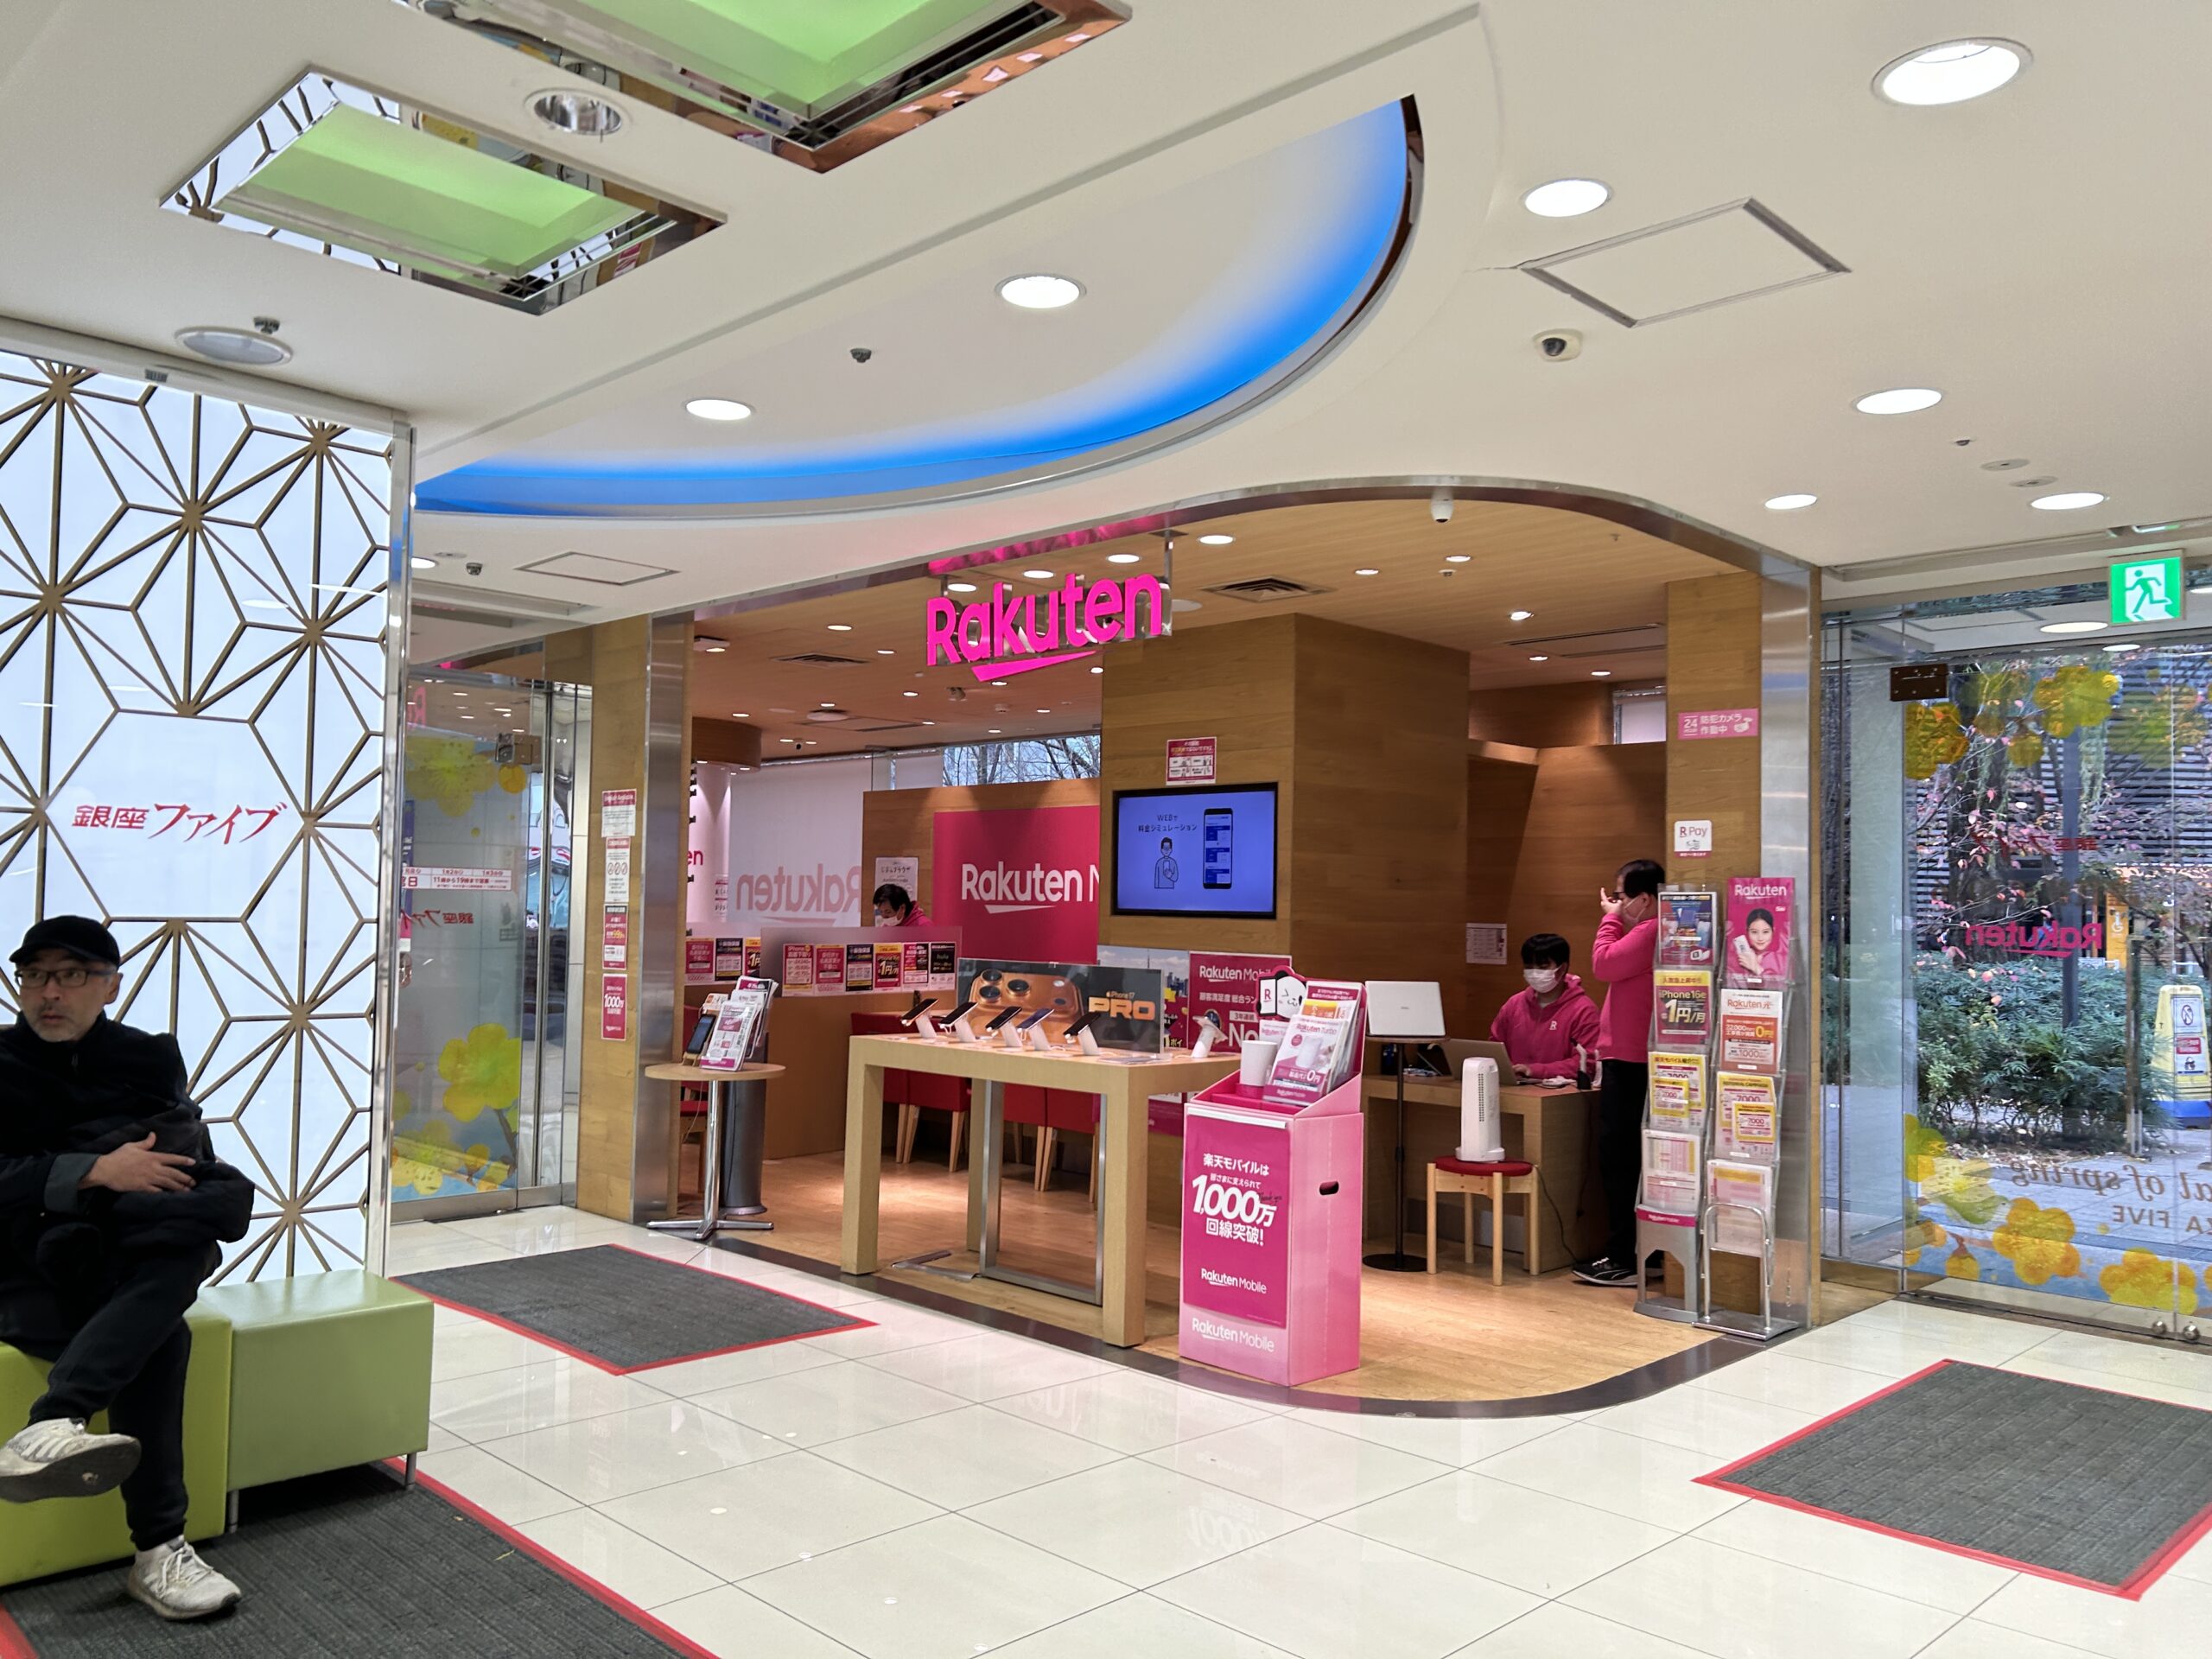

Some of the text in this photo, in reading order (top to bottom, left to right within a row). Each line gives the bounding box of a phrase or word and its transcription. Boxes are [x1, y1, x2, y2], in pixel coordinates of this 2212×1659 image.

[927, 573, 1162, 666] Rakuten
[1684, 718, 1697, 728] 24
[72, 803, 288, 845] 銀座ファイブ
[1689, 826, 1707, 836] Pay
[962, 861, 1083, 902] Rakuten
[1734, 884, 1787, 896] Rakuten
[1199, 965, 1243, 980] Rakuten
[1089, 996, 1155, 1020] PRO
[1728, 999, 1762, 1008] Rakuten
[1204, 1153, 1269, 1176] 楽天モバイルは
[1210, 1173, 1262, 1189] 皆さまに支えられて
[1205, 1217, 1264, 1246] 回線突破!
[1201, 1268, 1267, 1294] Rakuten Mobile
[1192, 1318, 1238, 1343] Rakuten
[1239, 1330, 1274, 1352] Mobile
